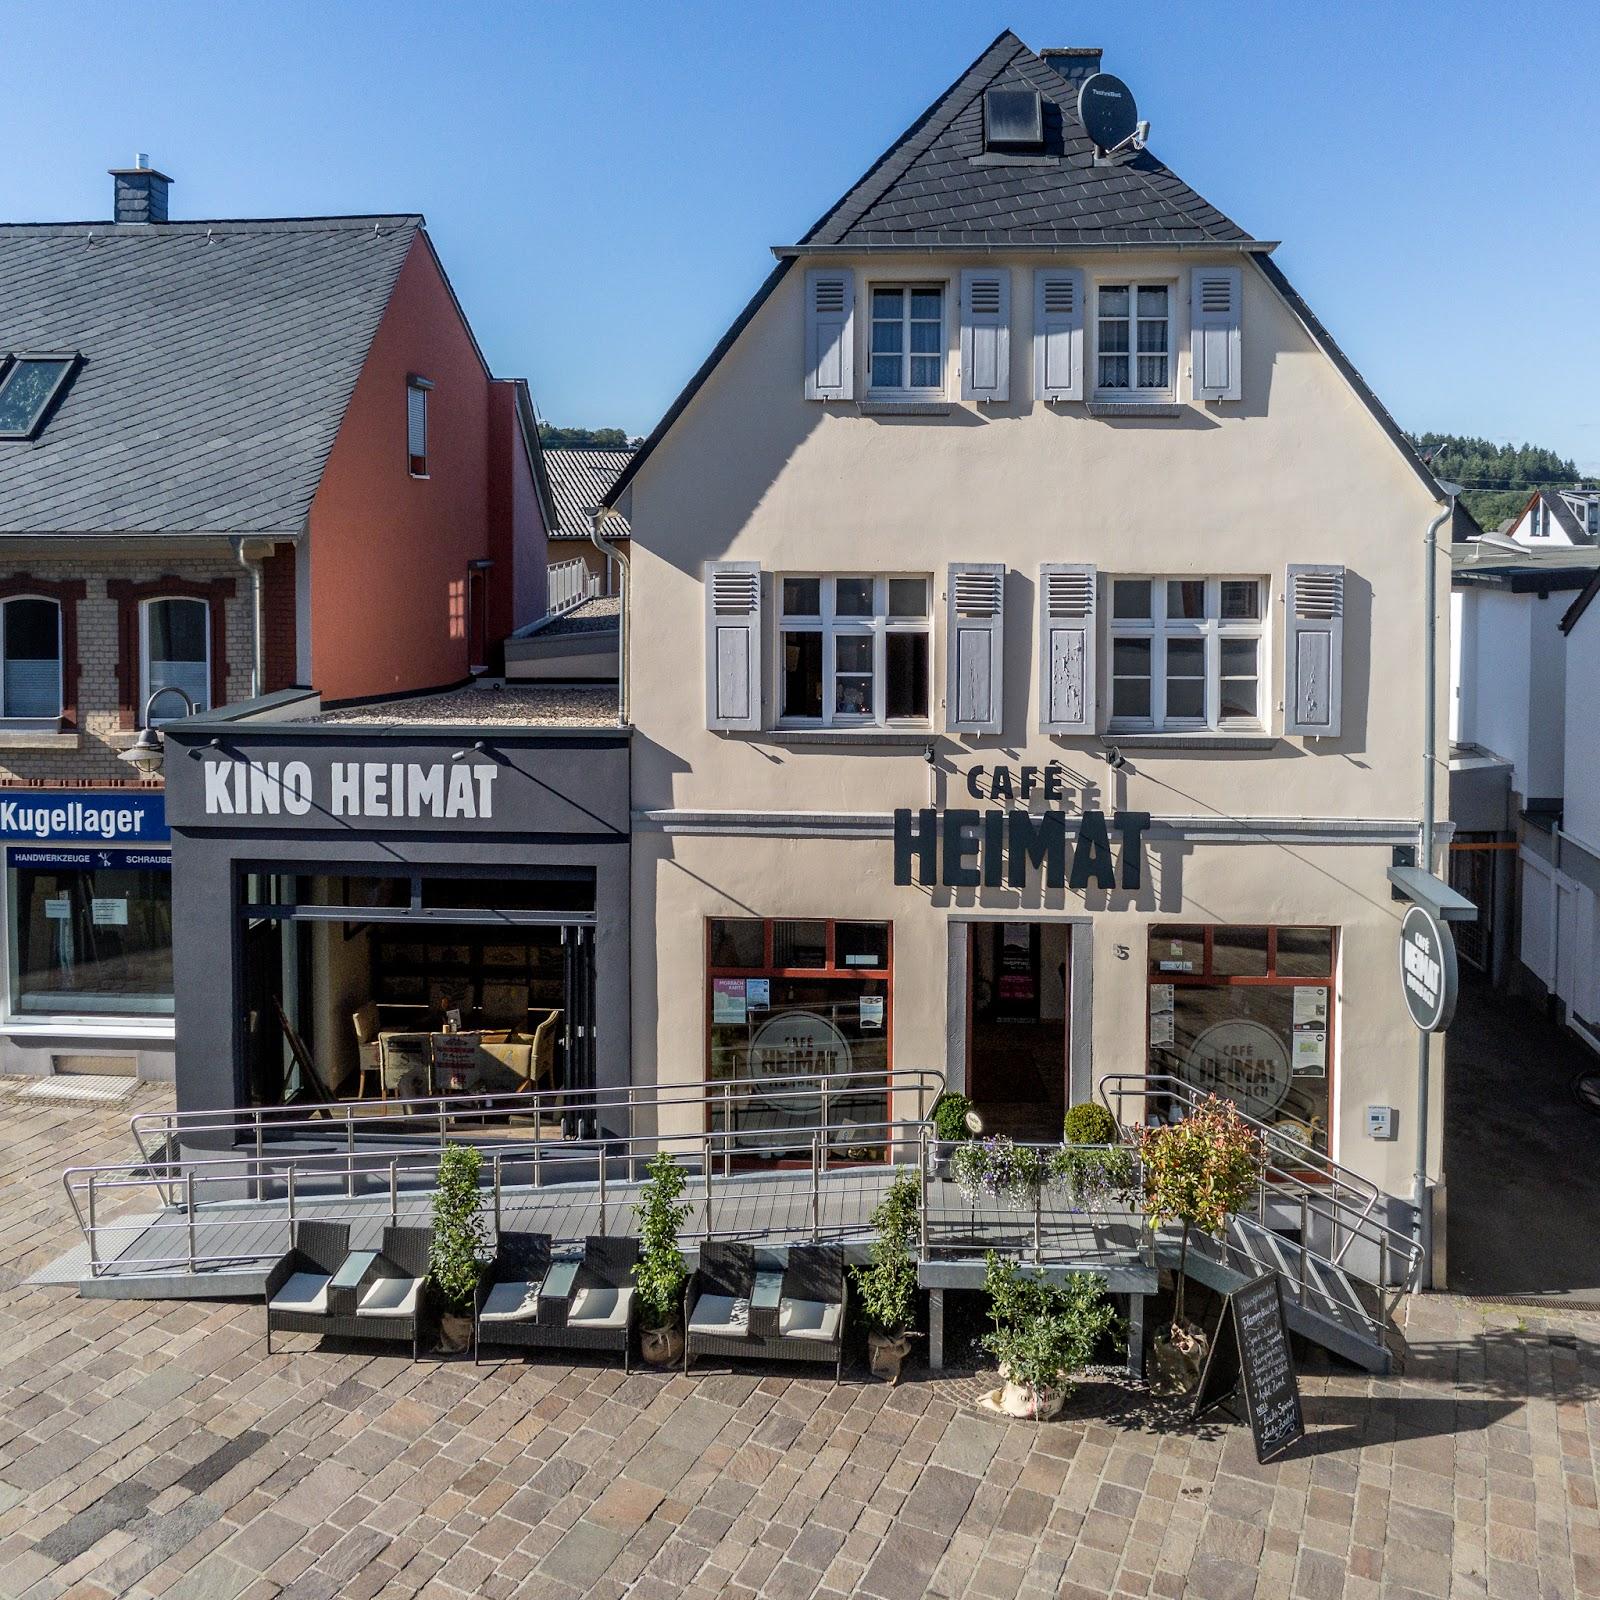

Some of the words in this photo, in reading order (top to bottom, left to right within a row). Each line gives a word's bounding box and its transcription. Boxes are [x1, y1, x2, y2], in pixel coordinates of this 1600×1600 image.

[204, 761, 312, 815] KINO
[331, 762, 498, 818] HEIMAT
[967, 760, 1062, 800] CAFÉ
[0, 802, 145, 838] Kugellager
[15, 853, 90, 863] HANDWERKZEUGE
[894, 808, 1150, 889] HEIMAT
